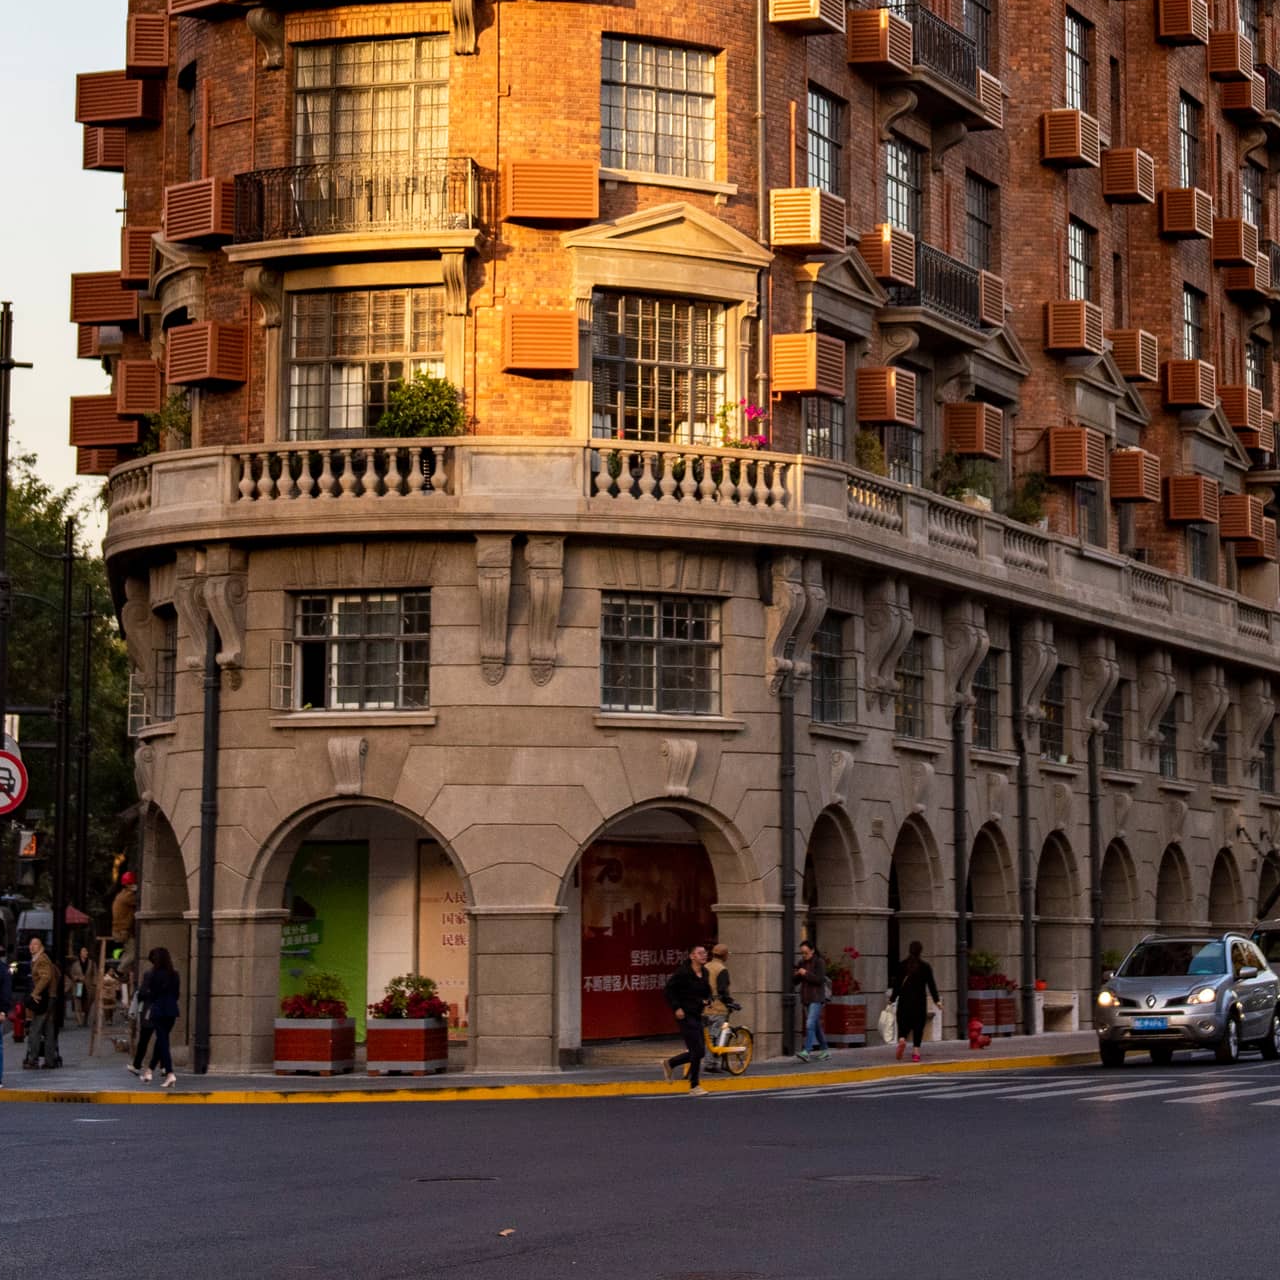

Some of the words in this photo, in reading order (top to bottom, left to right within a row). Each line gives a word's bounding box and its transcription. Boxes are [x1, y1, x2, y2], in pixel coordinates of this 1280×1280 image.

[442, 891, 467, 904] 人民
[441, 912, 467, 925] 国家
[442, 934, 467, 946] 民族
